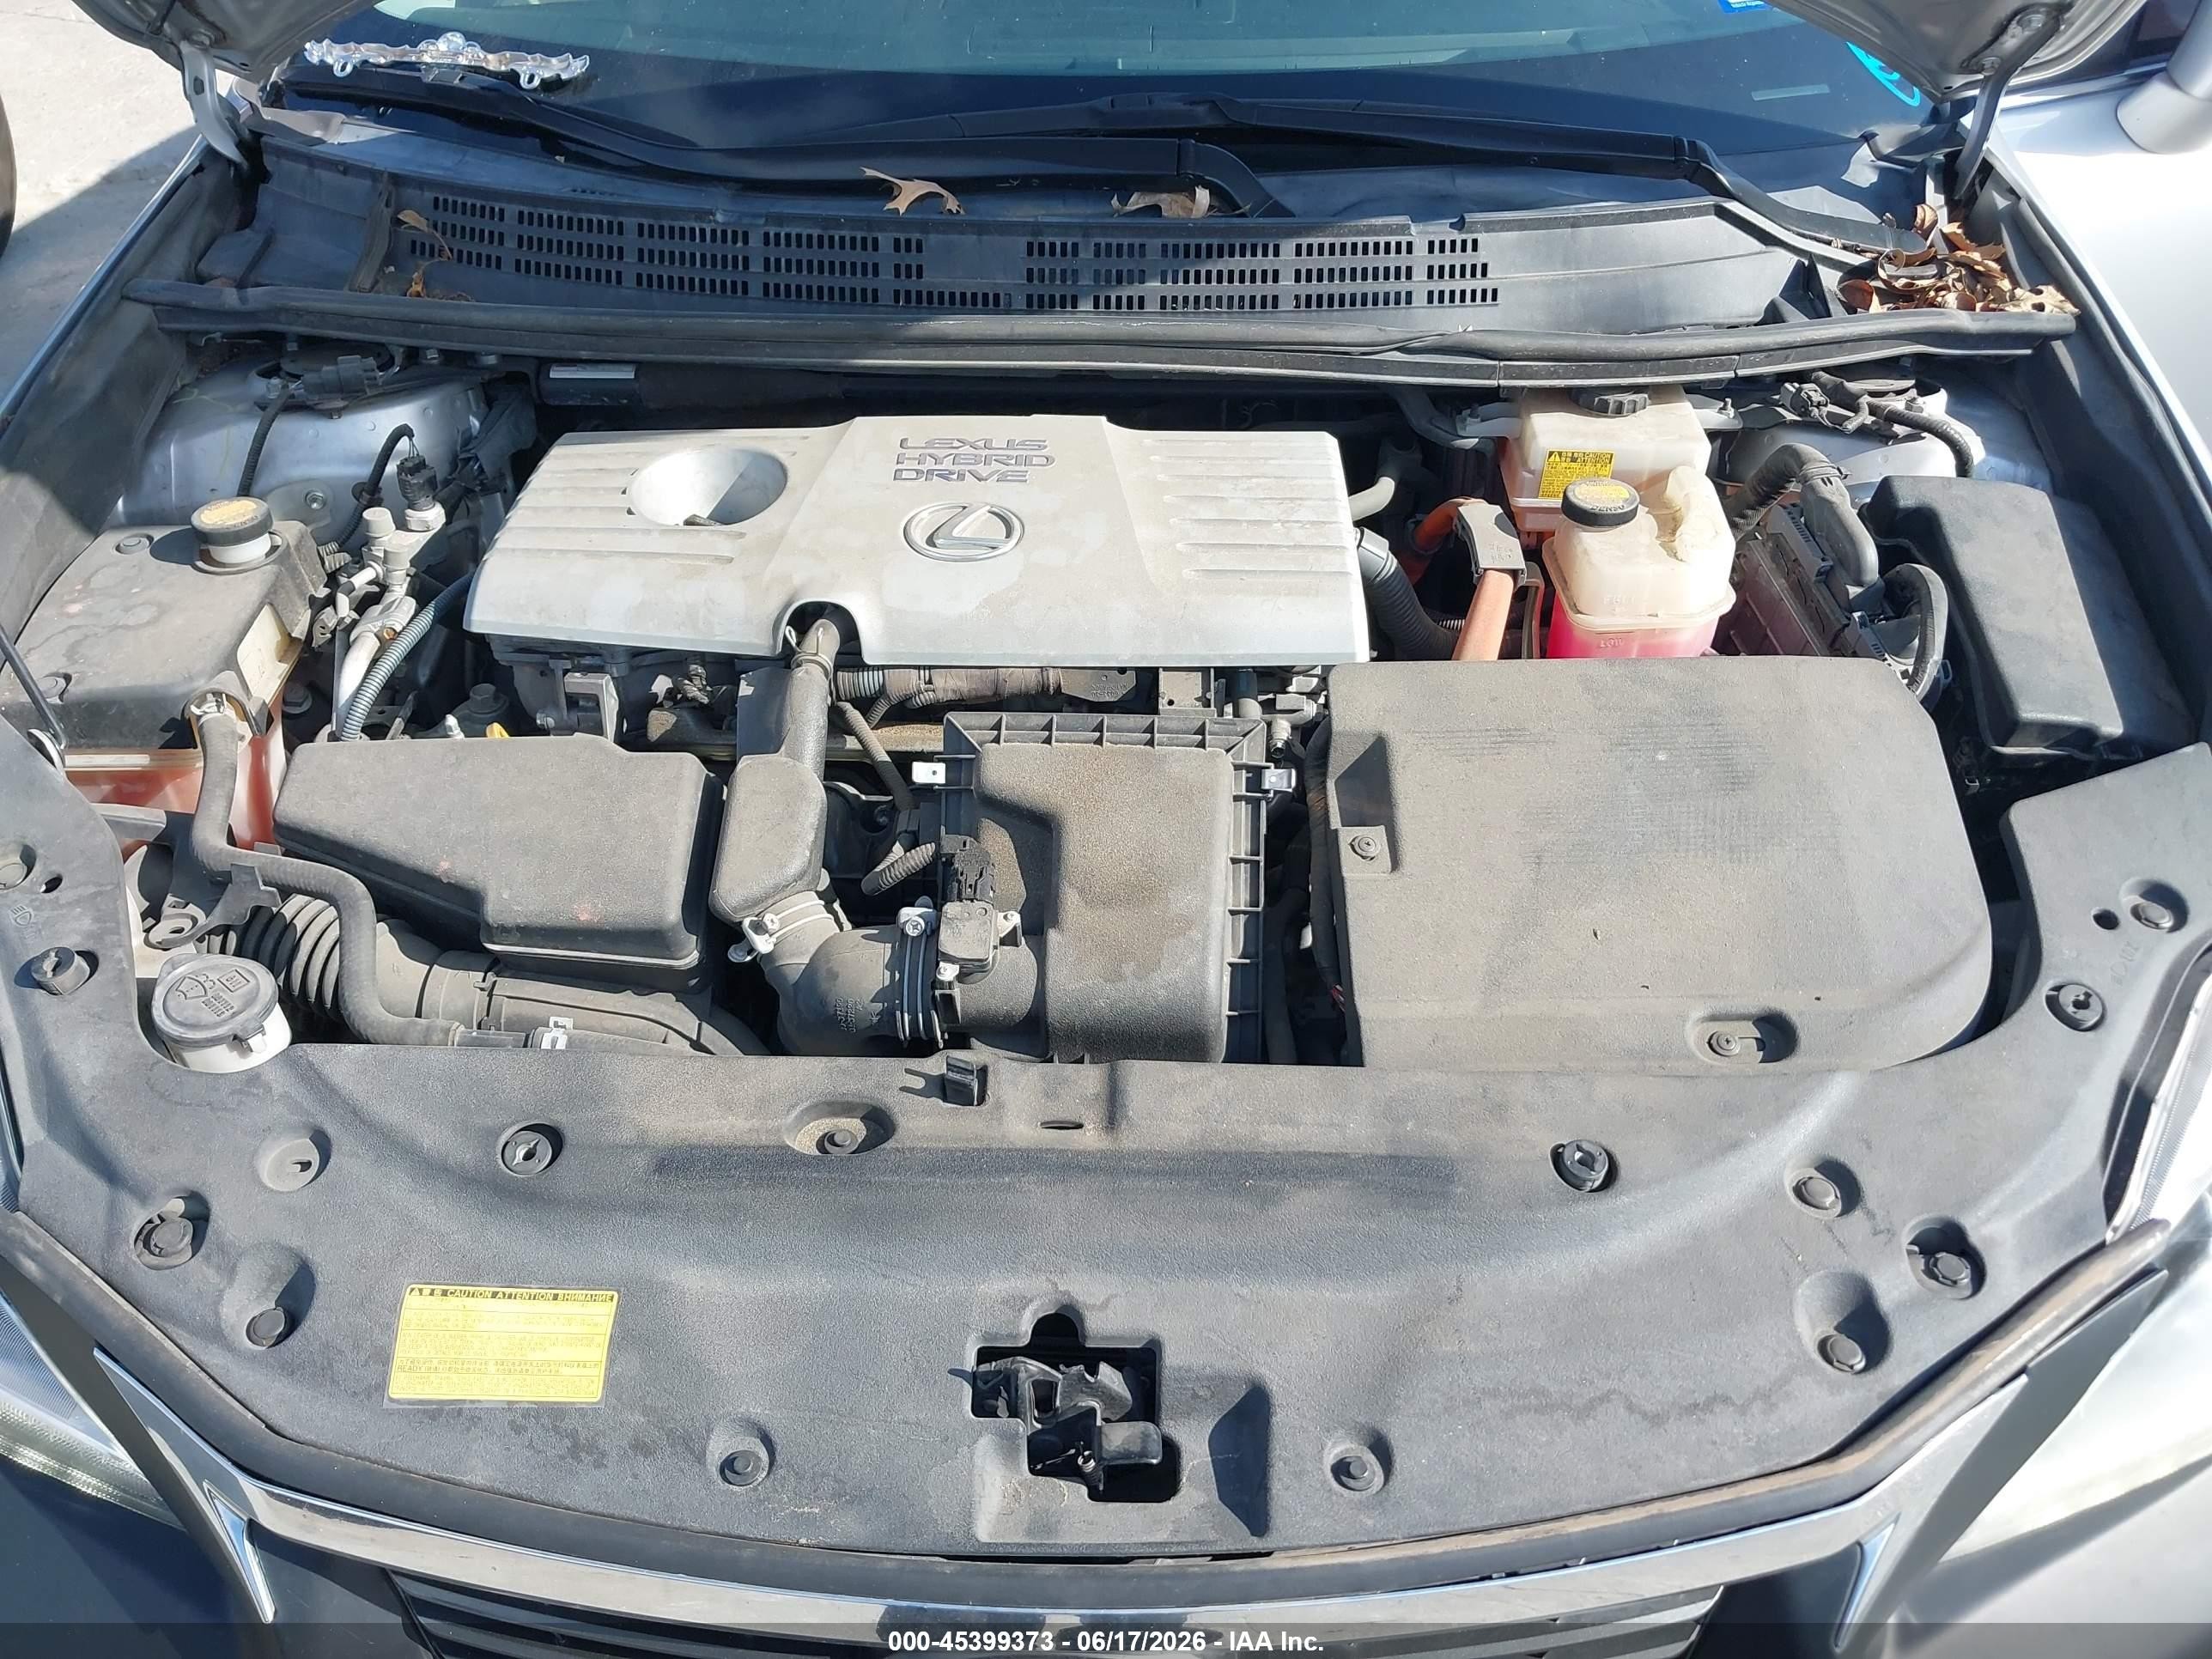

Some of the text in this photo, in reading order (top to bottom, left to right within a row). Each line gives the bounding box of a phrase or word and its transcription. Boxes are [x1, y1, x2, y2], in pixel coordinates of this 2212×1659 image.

[899, 438, 1048, 451] LEXUS
[896, 453, 1056, 467] HYBRID
[893, 468, 1029, 483] DRIVE
[447, 1288, 495, 1299] CAUTION
[495, 1290, 554, 1302] ATTENTION
[556, 1292, 613, 1304] ВНИМАНИЕ
